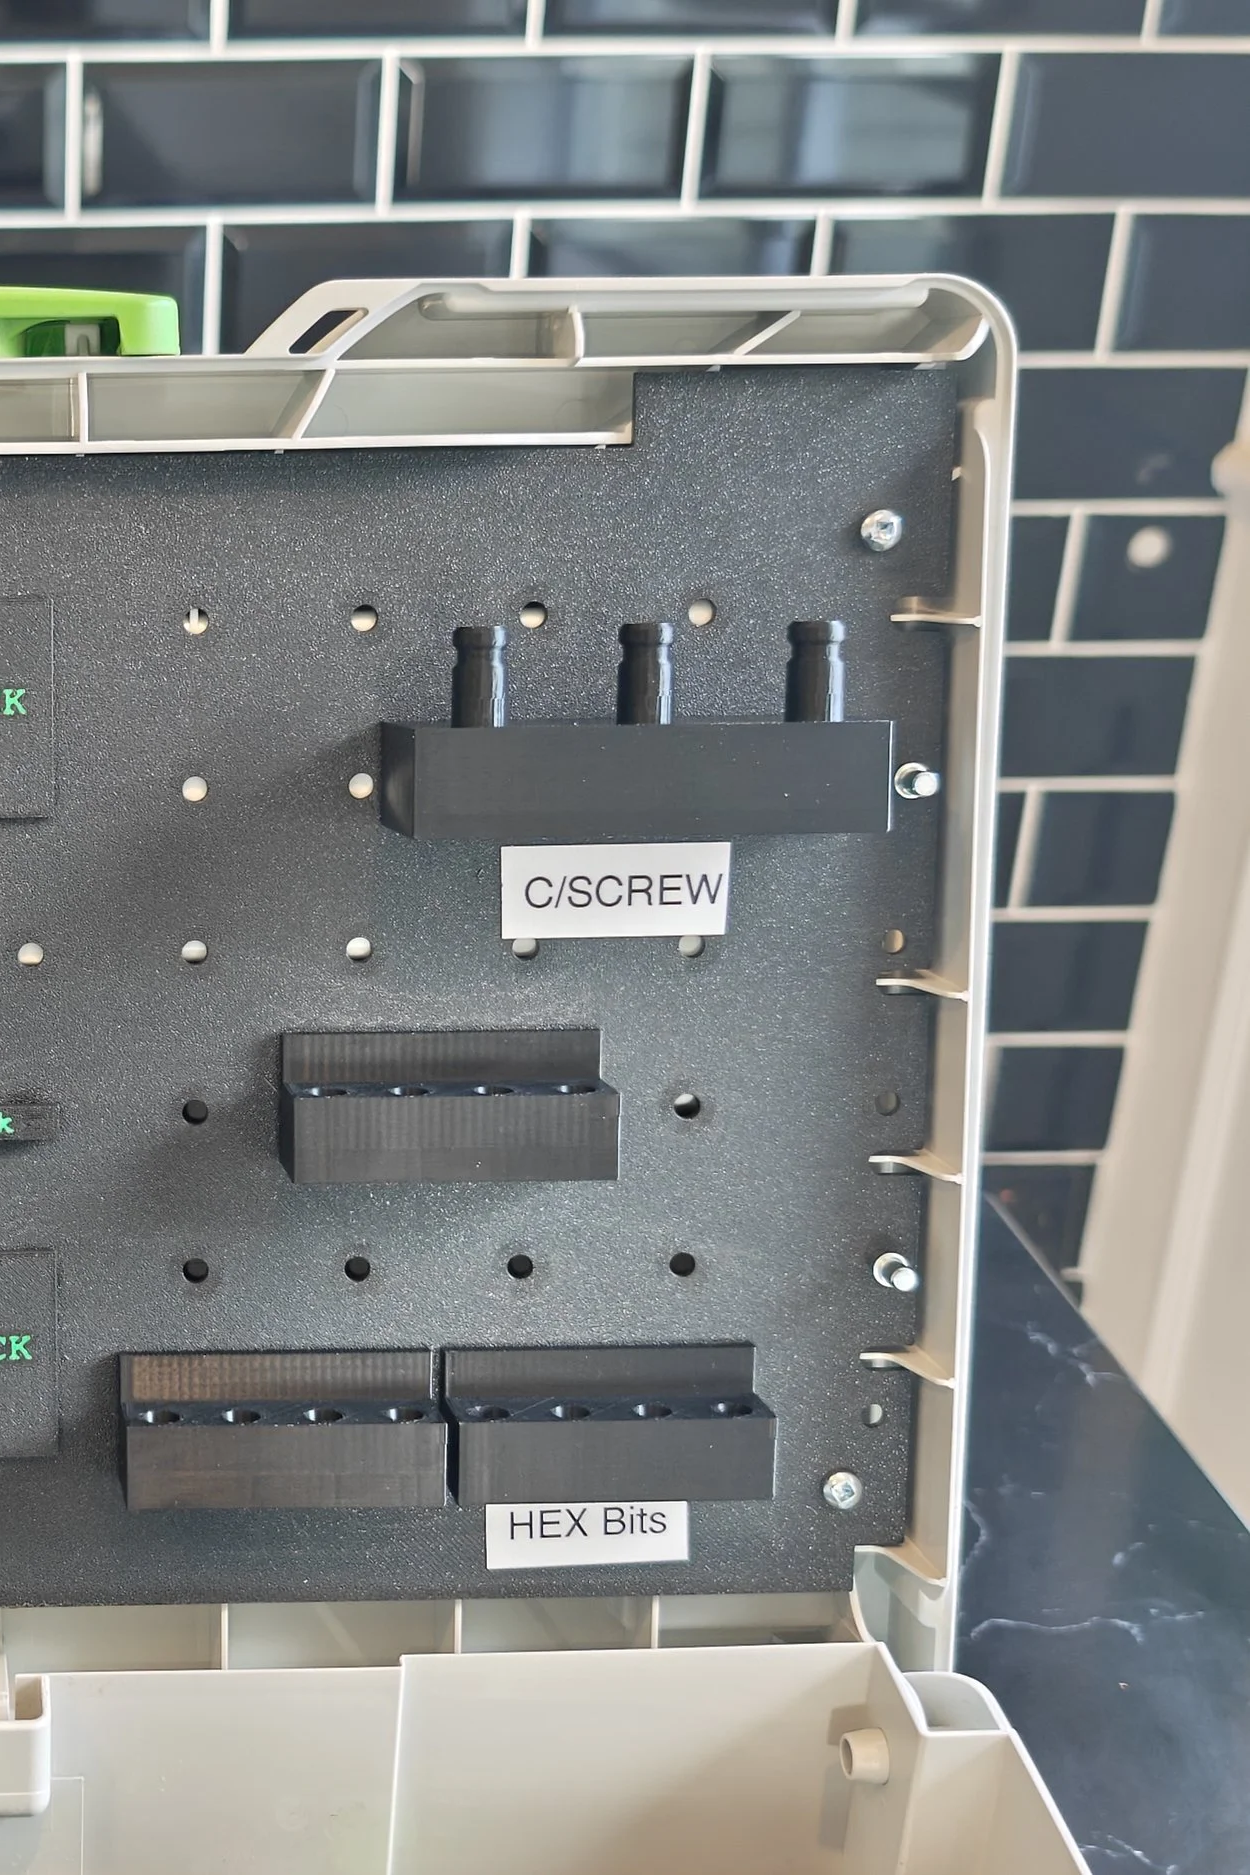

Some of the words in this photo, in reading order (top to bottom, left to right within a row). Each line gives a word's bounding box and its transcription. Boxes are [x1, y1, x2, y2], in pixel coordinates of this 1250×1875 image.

[525, 873, 723, 908] C/SCREW
[510, 1508, 588, 1539] HEX
[604, 1506, 667, 1535] Bits
